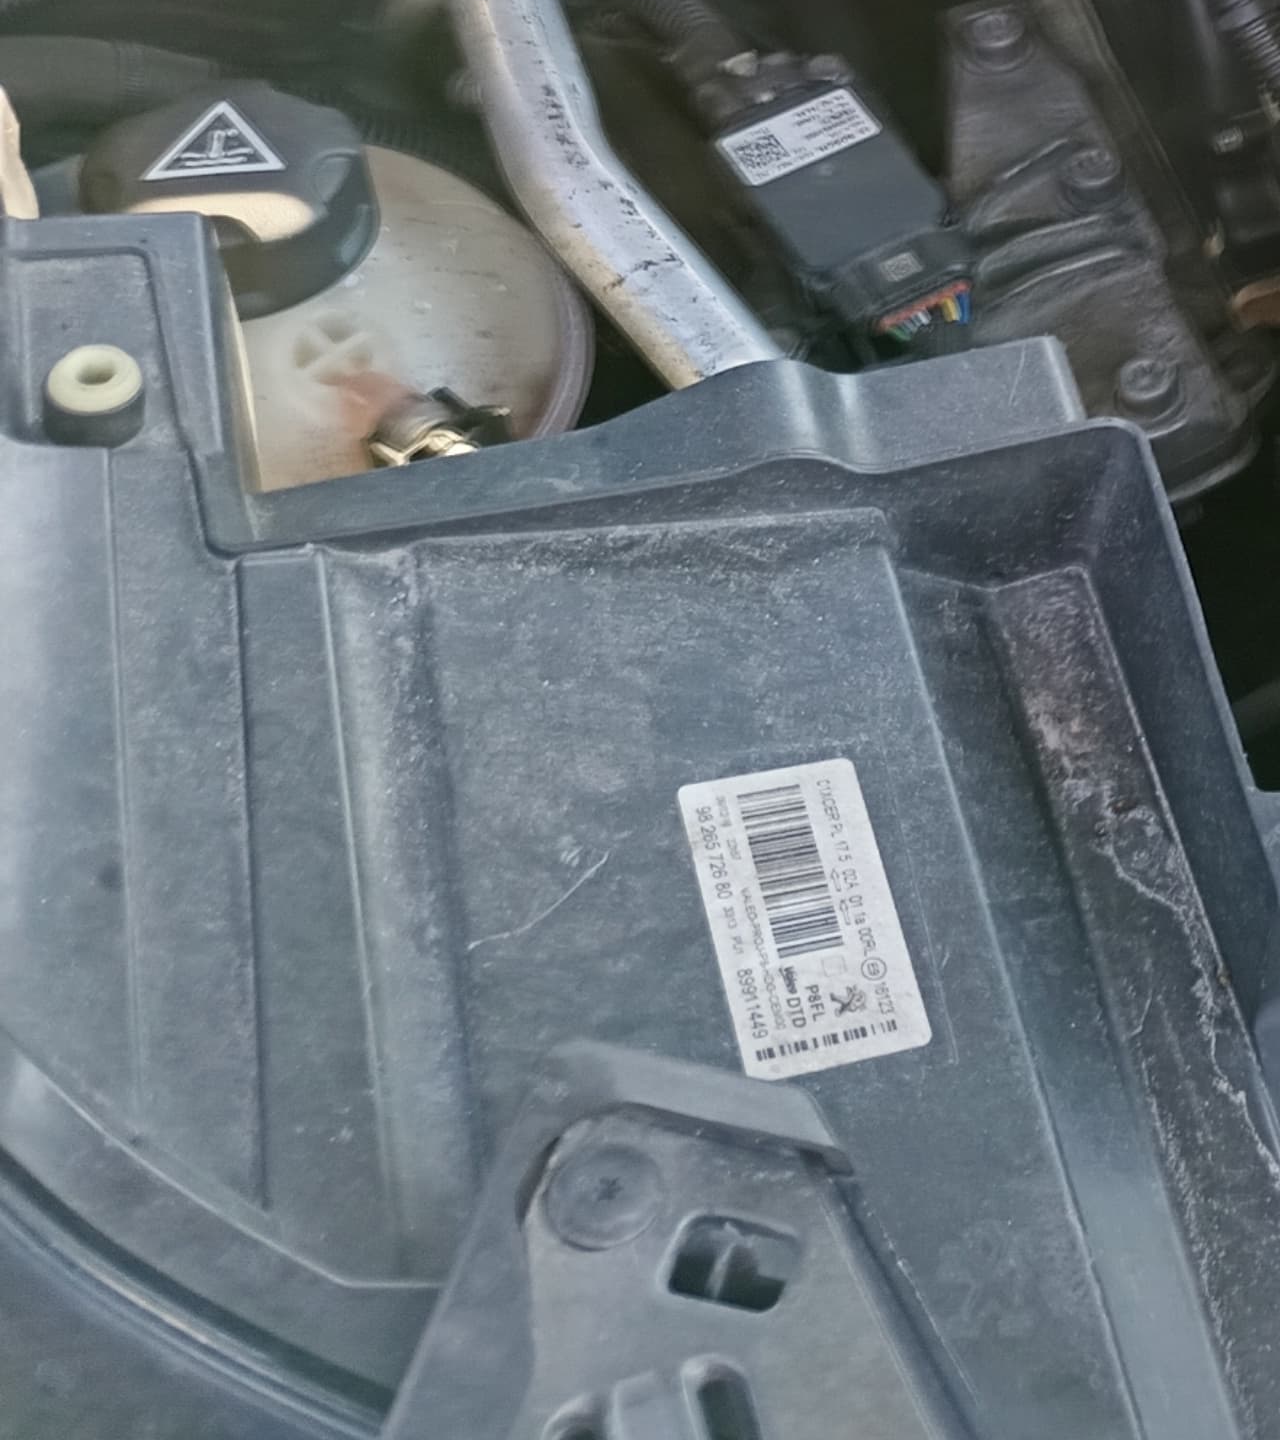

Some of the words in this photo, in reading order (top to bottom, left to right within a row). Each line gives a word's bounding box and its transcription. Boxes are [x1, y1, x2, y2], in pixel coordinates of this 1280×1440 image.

[695, 805, 714, 823] 98
[699, 824, 721, 850] 265
[707, 852, 728, 879] 726
[714, 880, 734, 900] 80
[735, 967, 769, 1040] 89911449
[785, 995, 807, 1029] DTD
[804, 983, 827, 1022] P8FL
